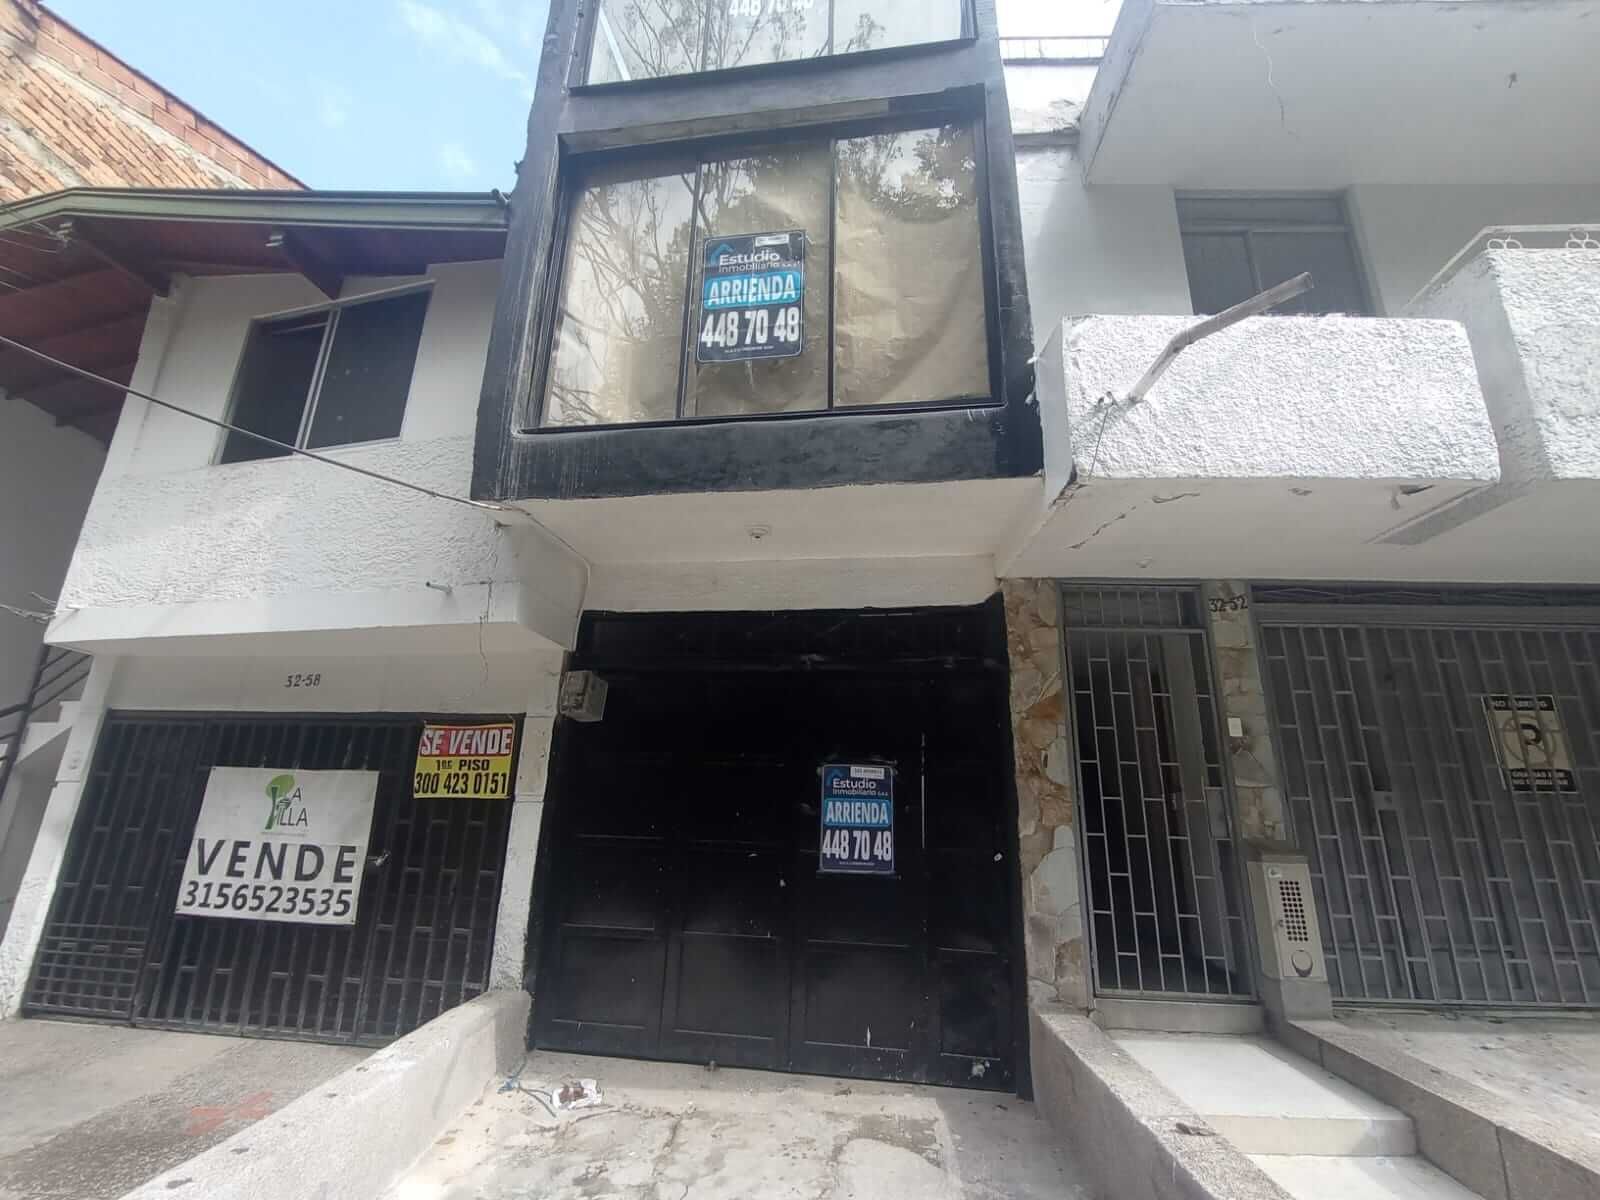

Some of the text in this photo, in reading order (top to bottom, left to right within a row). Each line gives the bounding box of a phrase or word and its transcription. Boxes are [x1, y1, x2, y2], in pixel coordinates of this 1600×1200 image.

[719, 249, 780, 266] Estudio
[708, 274, 796, 305] ARRIENDA
[701, 307, 800, 348] 448 70 48
[284, 673, 321, 688] 32-58
[420, 728, 512, 755] SE VENDE
[459, 759, 490, 771] PISO
[414, 772, 508, 794] 300 423 0151
[832, 777, 877, 790] Estudio
[826, 801, 889, 825] ARRIENDA
[822, 829, 892, 861] 448 70 48
[197, 838, 357, 883] VENDE
[182, 880, 352, 917] 3156523535
